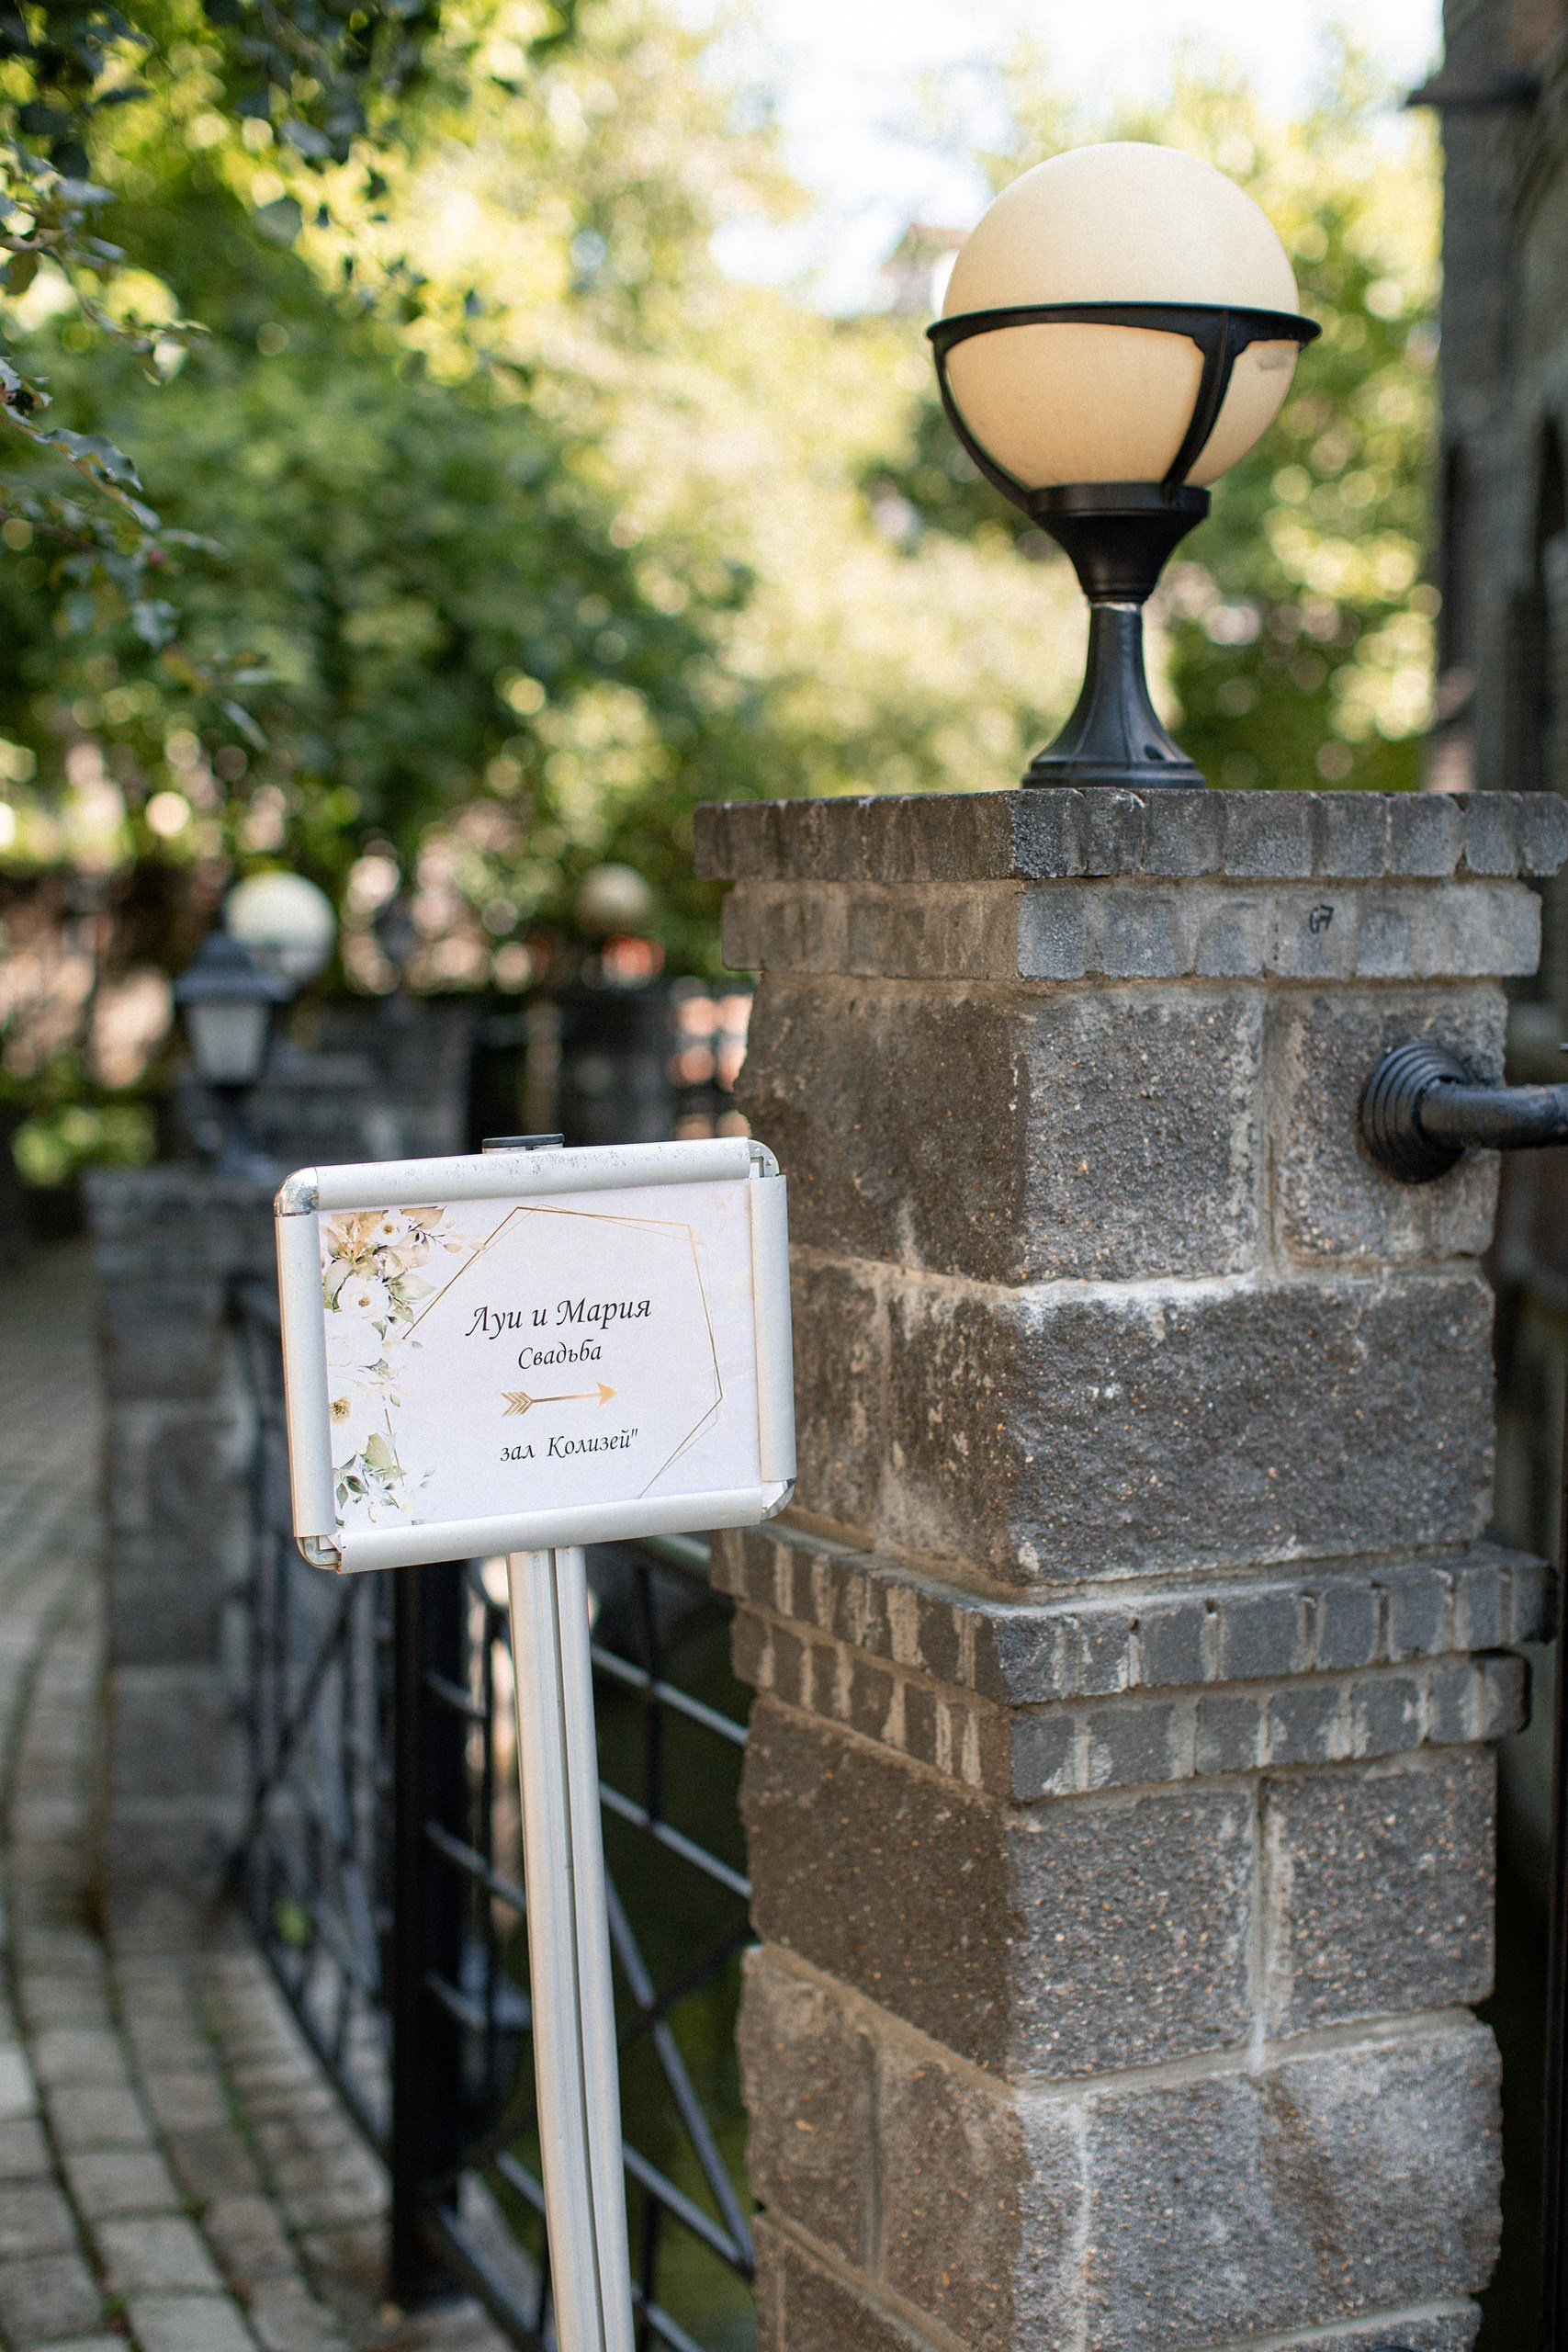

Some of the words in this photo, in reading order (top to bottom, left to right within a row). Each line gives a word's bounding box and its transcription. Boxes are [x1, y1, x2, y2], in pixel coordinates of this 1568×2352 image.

[465, 1306, 524, 1340] Луи
[531, 1308, 548, 1327] и
[556, 1297, 652, 1330] Мария
[518, 1339, 603, 1370] Свадьба
[500, 1444, 536, 1462] зал
[547, 1428, 638, 1459] Колизей"
